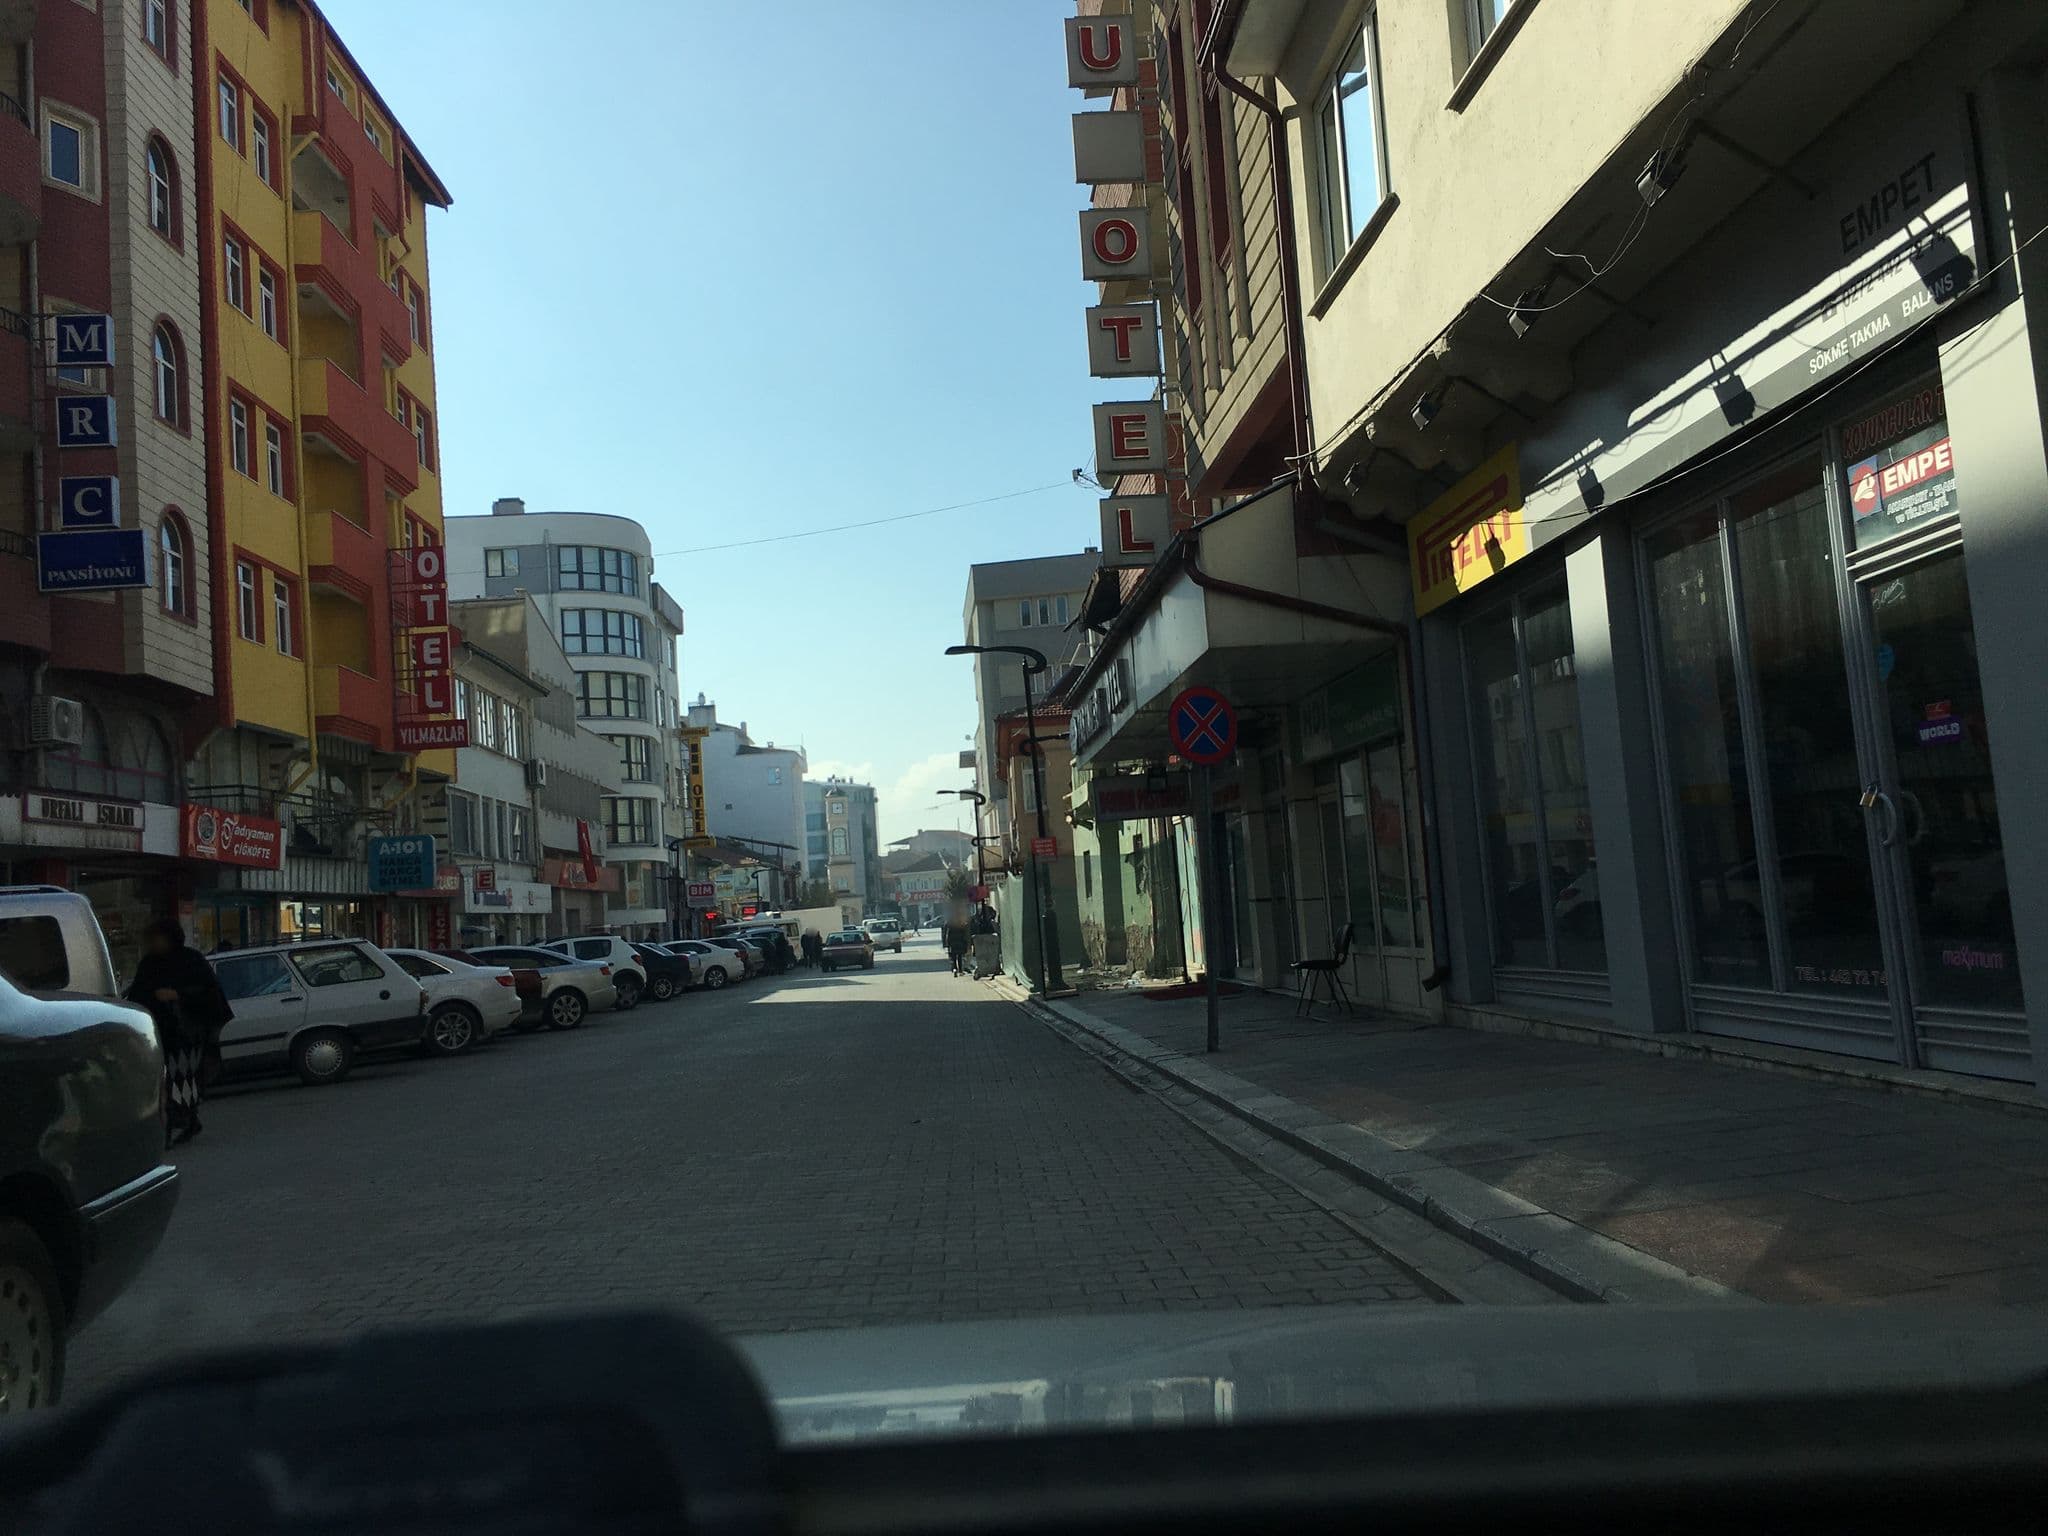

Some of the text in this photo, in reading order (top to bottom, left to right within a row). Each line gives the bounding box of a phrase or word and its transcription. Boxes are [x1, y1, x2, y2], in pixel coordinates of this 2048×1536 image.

[1840, 152, 1936, 256] EMPET
[1809, 273, 1954, 375] SÖKME TAKMA BALANS
[1093, 218, 1153, 553] OTEL
[1883, 440, 1952, 493] EMPE
[47, 564, 137, 583] PANSİYONU
[416, 550, 444, 709] OTEL
[400, 725, 465, 745] YILMAZLAR
[1919, 722, 1961, 741] WORLD
